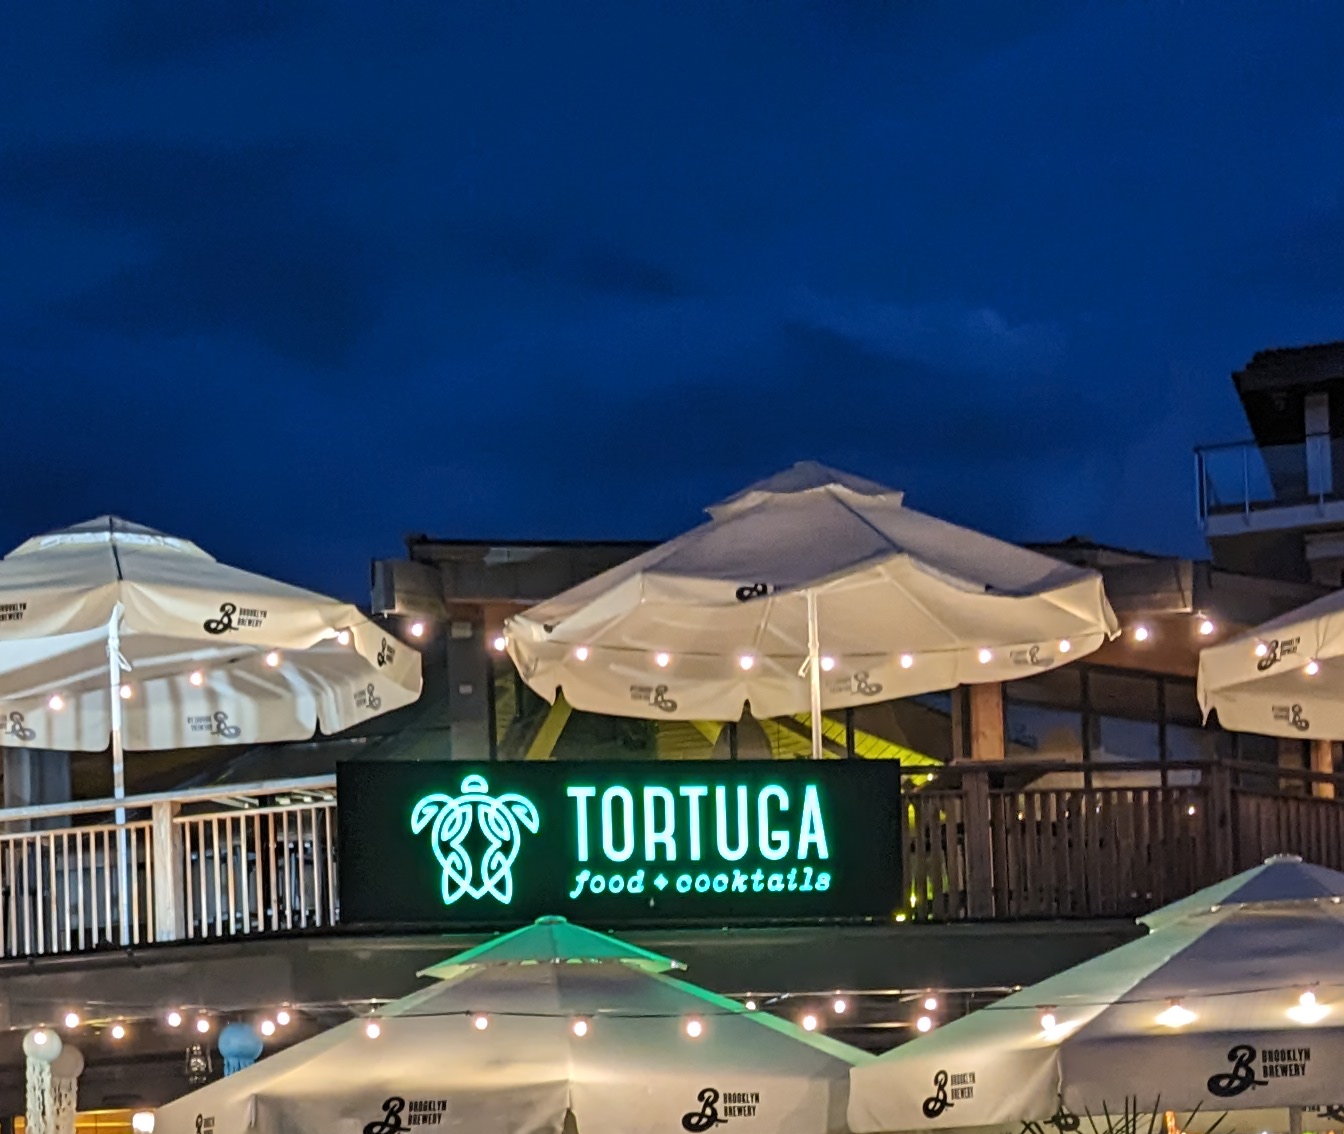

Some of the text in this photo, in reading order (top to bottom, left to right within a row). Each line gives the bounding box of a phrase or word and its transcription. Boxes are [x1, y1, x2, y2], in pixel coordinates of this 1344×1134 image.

[566, 784, 829, 862] TORTUGA
[569, 866, 832, 899] food cocktails
[1261, 1047, 1311, 1063] BROOKLYN
[1262, 1063, 1306, 1078] BREWERY
[723, 1092, 760, 1104] BROOKLYN
[408, 1099, 447, 1112] BROOKLYN
[723, 1105, 757, 1117] BREWERY
[408, 1112, 442, 1126] BREWERY
